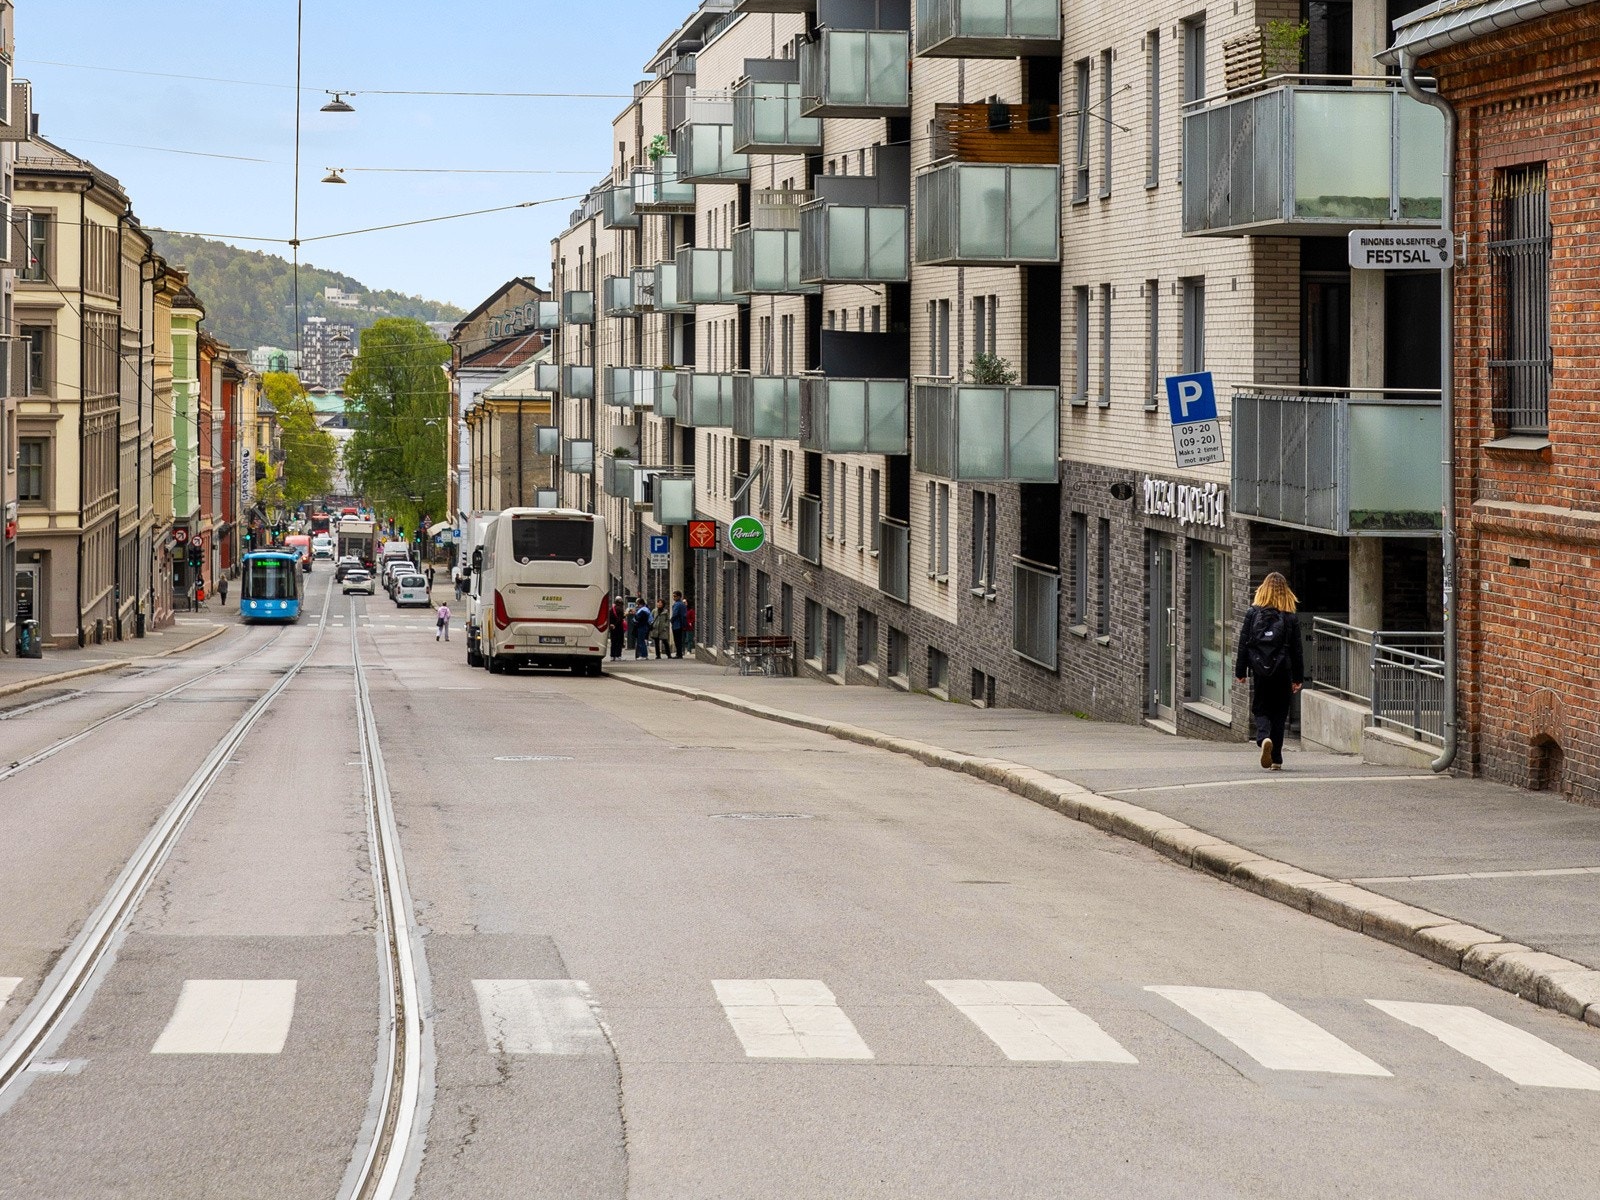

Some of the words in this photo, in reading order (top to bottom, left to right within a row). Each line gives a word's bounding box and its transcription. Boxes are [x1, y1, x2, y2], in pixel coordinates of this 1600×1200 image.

[1360, 238, 1394, 246] RINGNES
[1396, 238, 1436, 246] ØLSENTER
[1366, 249, 1431, 264] FESTSAL
[1177, 380, 1203, 417] P
[1179, 448, 1195, 457] Maks
[1199, 454, 1216, 463] avgift
[1143, 474, 1176, 518] PIZZA
[733, 527, 761, 540] Render
[654, 537, 664, 551] P
